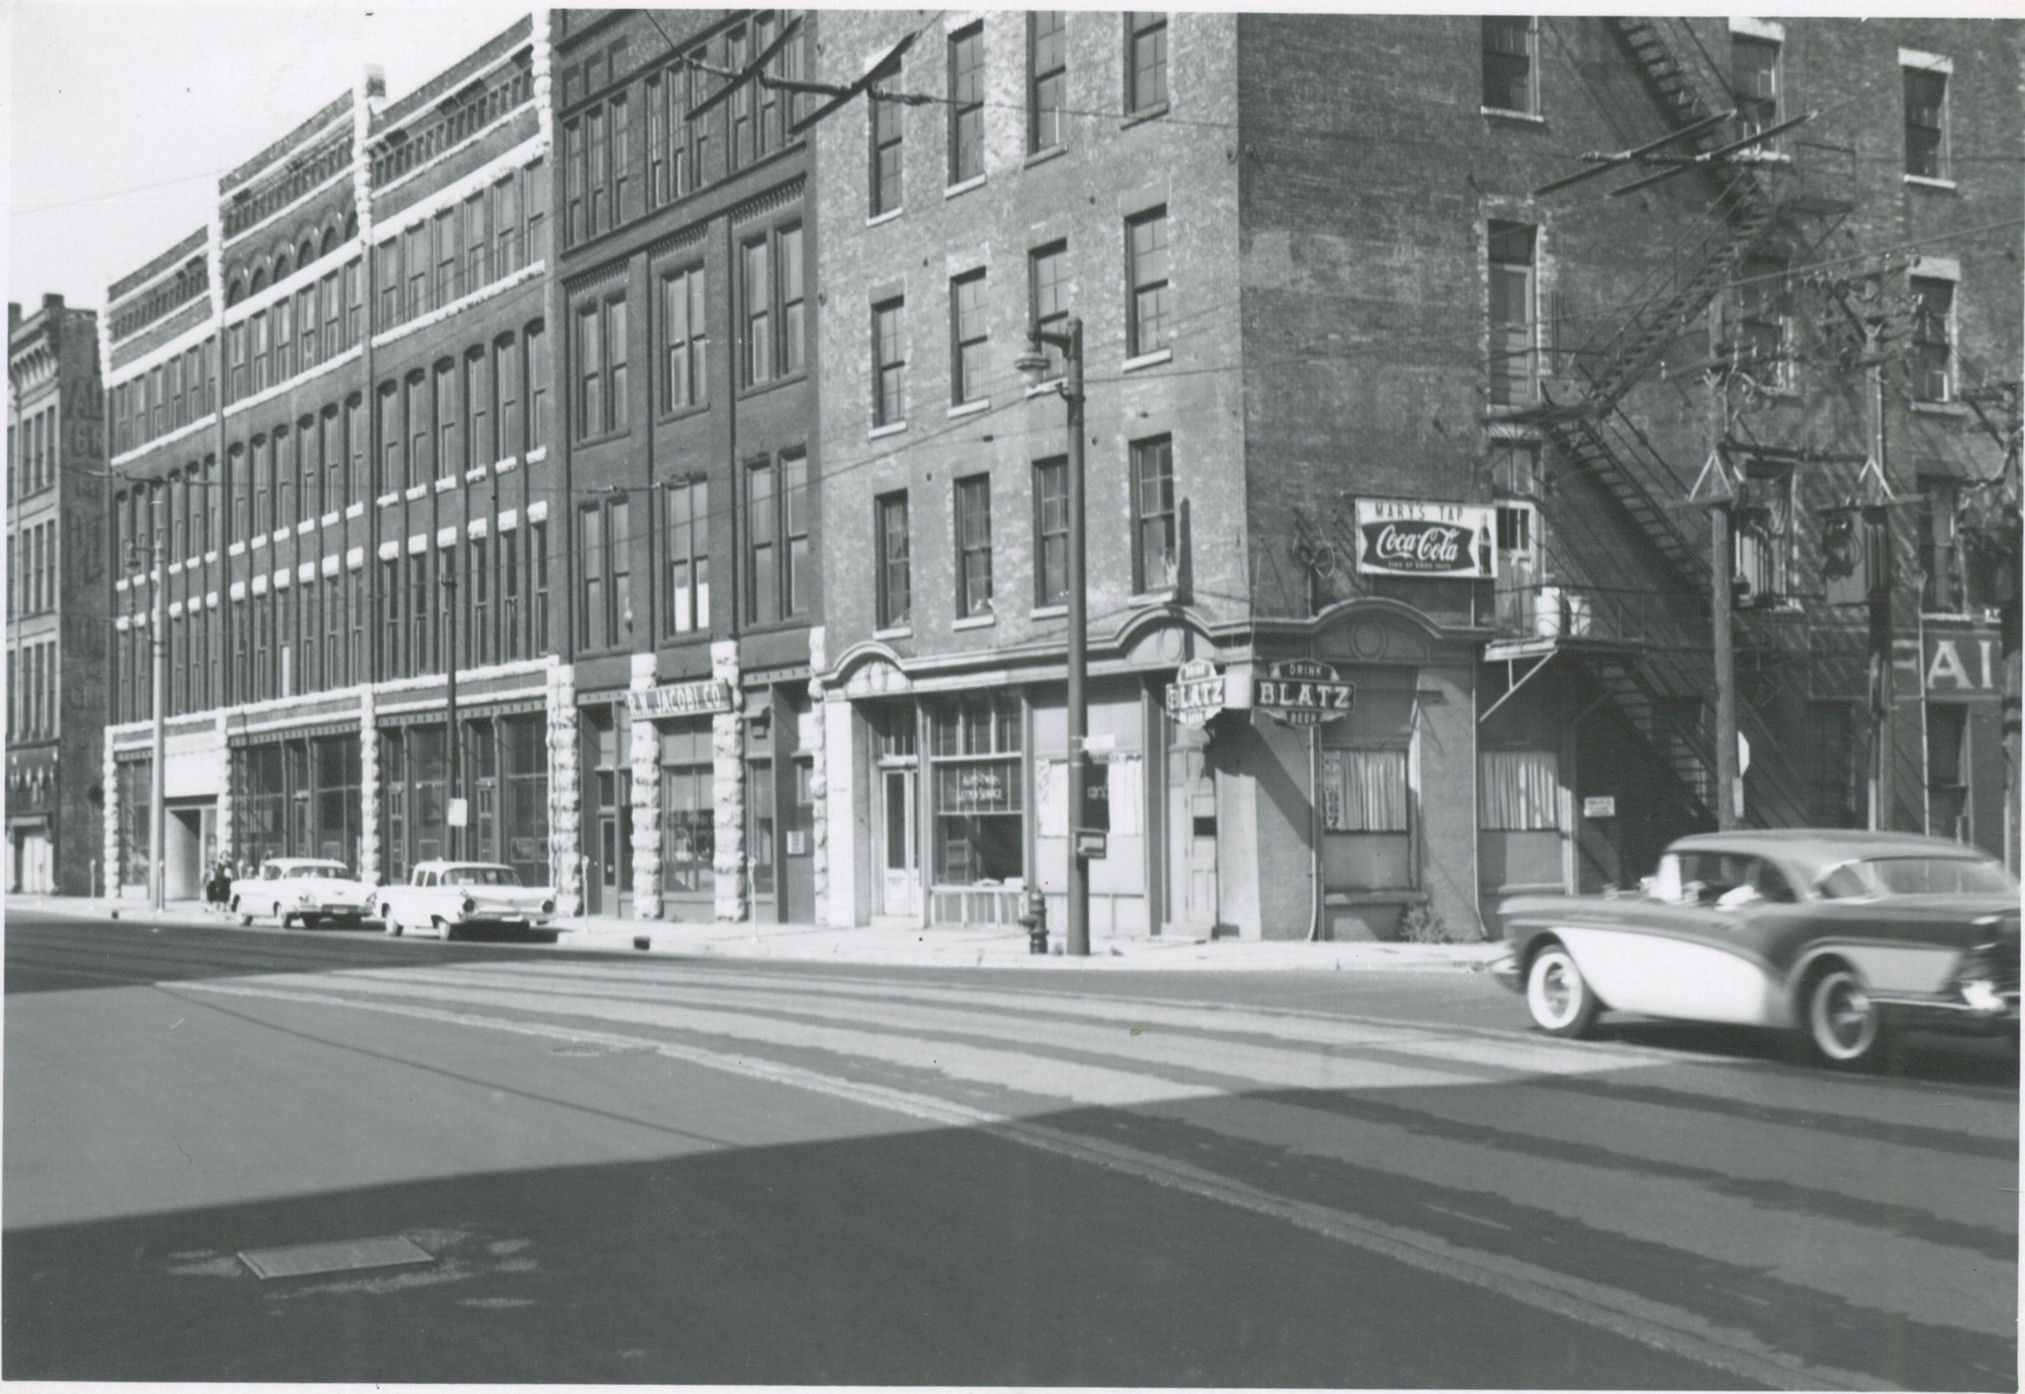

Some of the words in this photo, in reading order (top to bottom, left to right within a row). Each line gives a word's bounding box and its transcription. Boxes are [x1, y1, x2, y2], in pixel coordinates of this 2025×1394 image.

[1374, 502, 1425, 520] MARY'S
[1438, 506, 1463, 521] TAP
[1289, 663, 1322, 677] DRINK
[1260, 681, 1350, 708] BLATZ
